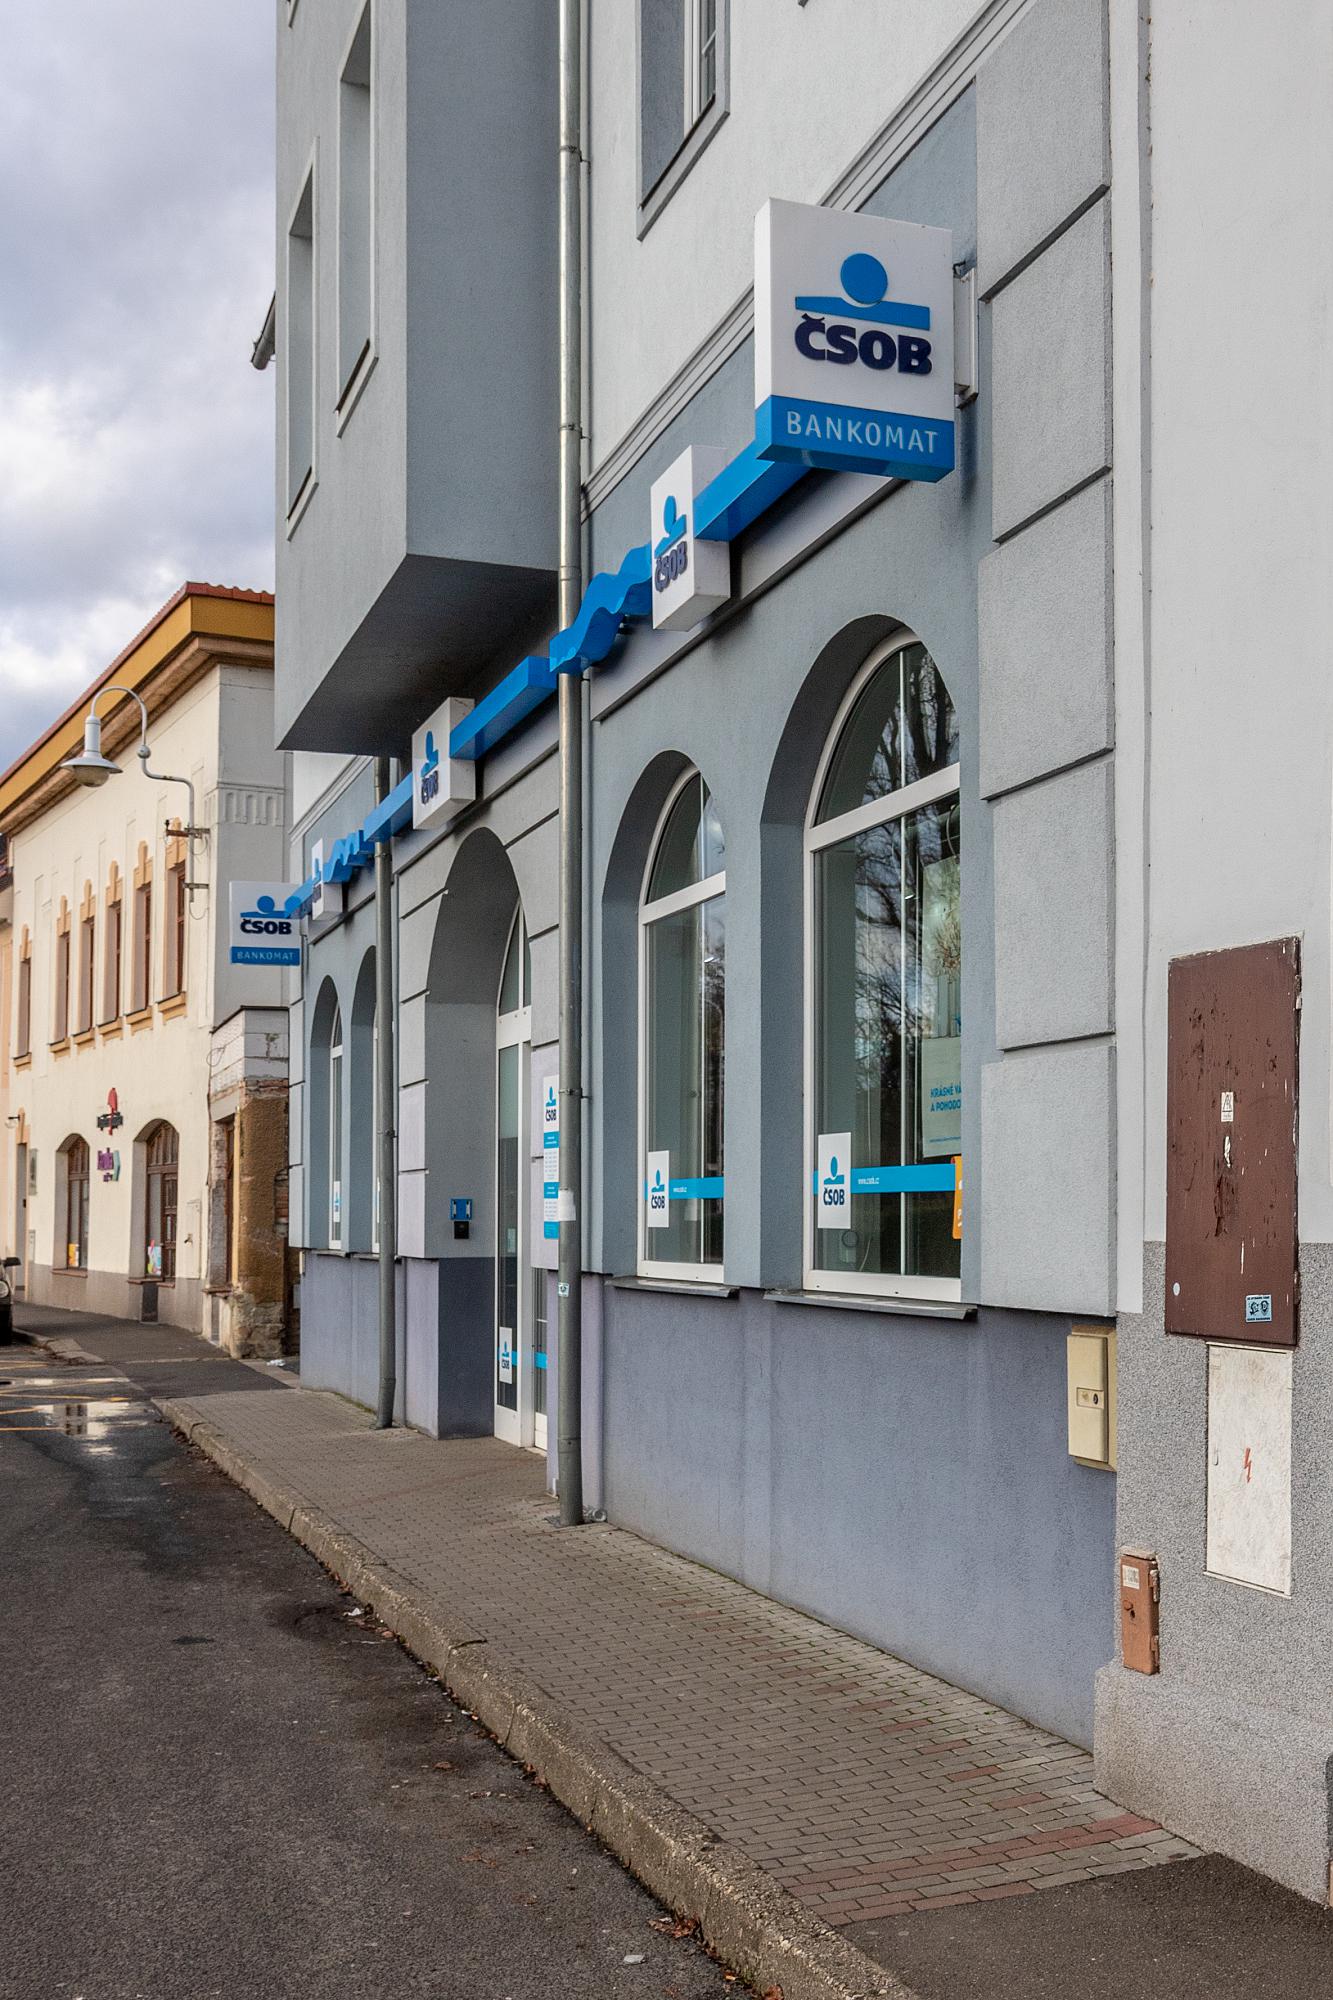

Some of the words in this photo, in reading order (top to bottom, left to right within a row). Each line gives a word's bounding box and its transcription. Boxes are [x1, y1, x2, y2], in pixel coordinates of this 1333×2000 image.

[794, 313, 932, 375] ČSOB
[787, 410, 939, 454] BANKOMAT
[653, 541, 688, 593] ČSOB
[240, 918, 292, 935] ČSOB
[237, 951, 294, 961] BANKOMAT
[651, 1194, 665, 1209] ČSOB
[823, 1187, 845, 1206] ČSOB
